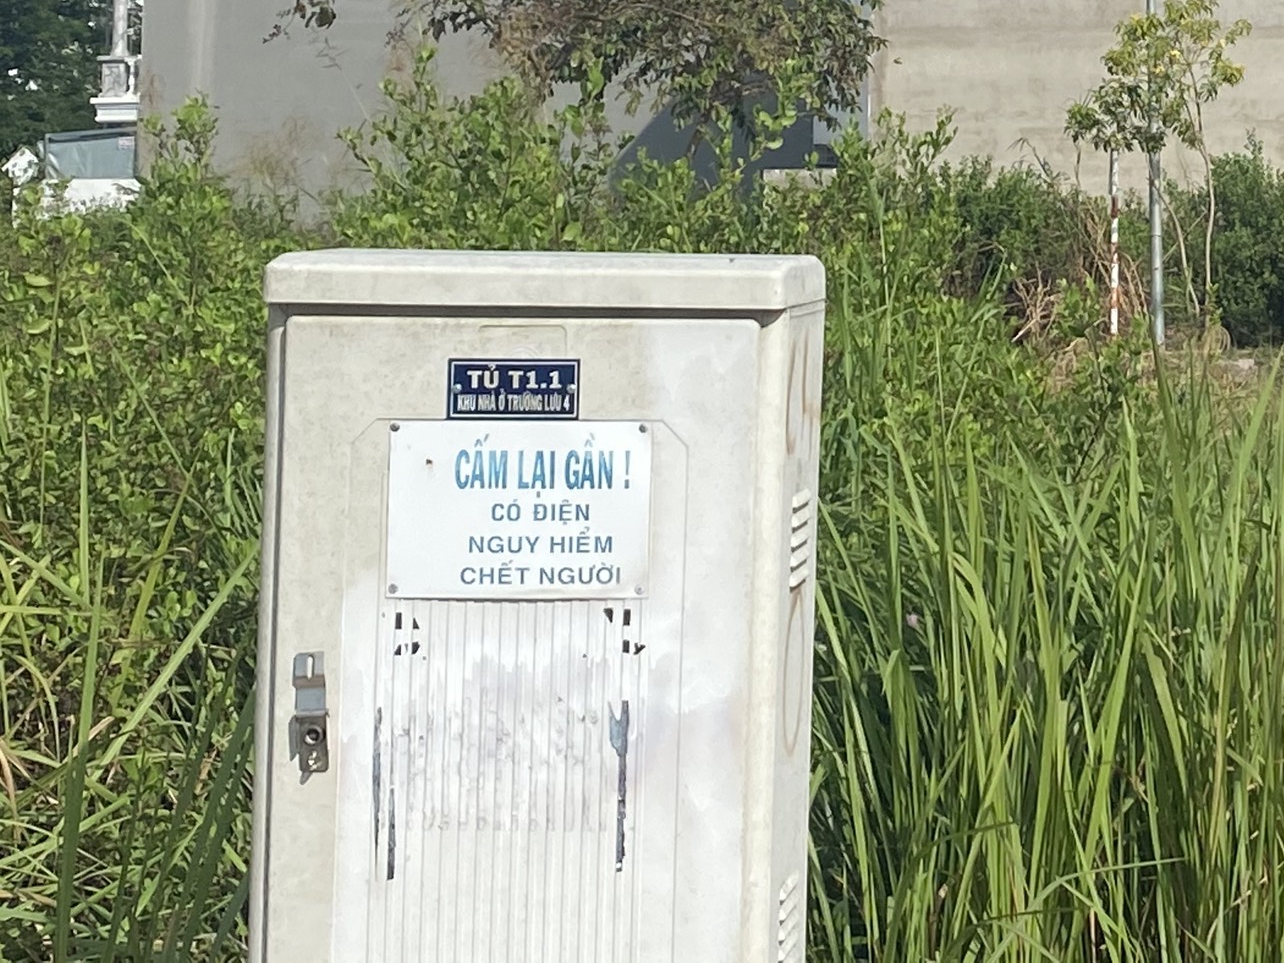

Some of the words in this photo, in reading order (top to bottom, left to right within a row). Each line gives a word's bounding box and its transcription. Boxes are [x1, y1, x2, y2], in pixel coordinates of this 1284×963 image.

[467, 363, 499, 389] TỦ
[508, 370, 562, 389] T1.1
[457, 394, 476, 412] KHU
[478, 390, 496, 411] NHÀ
[498, 388, 506, 411] Ở
[563, 394, 570, 411] 4
[454, 433, 508, 490] CẤM
[517, 450, 556, 499] LẠI
[564, 433, 614, 490] GẦN
[624, 450, 631, 489] !
[491, 499, 521, 521] CÓ
[533, 499, 591, 525] ĐIỆN
[468, 536, 540, 553] NGUY
[549, 527, 613, 553] HIỂM
[459, 560, 530, 584] CHẾT
[539, 562, 621, 584] NGƯỜI
